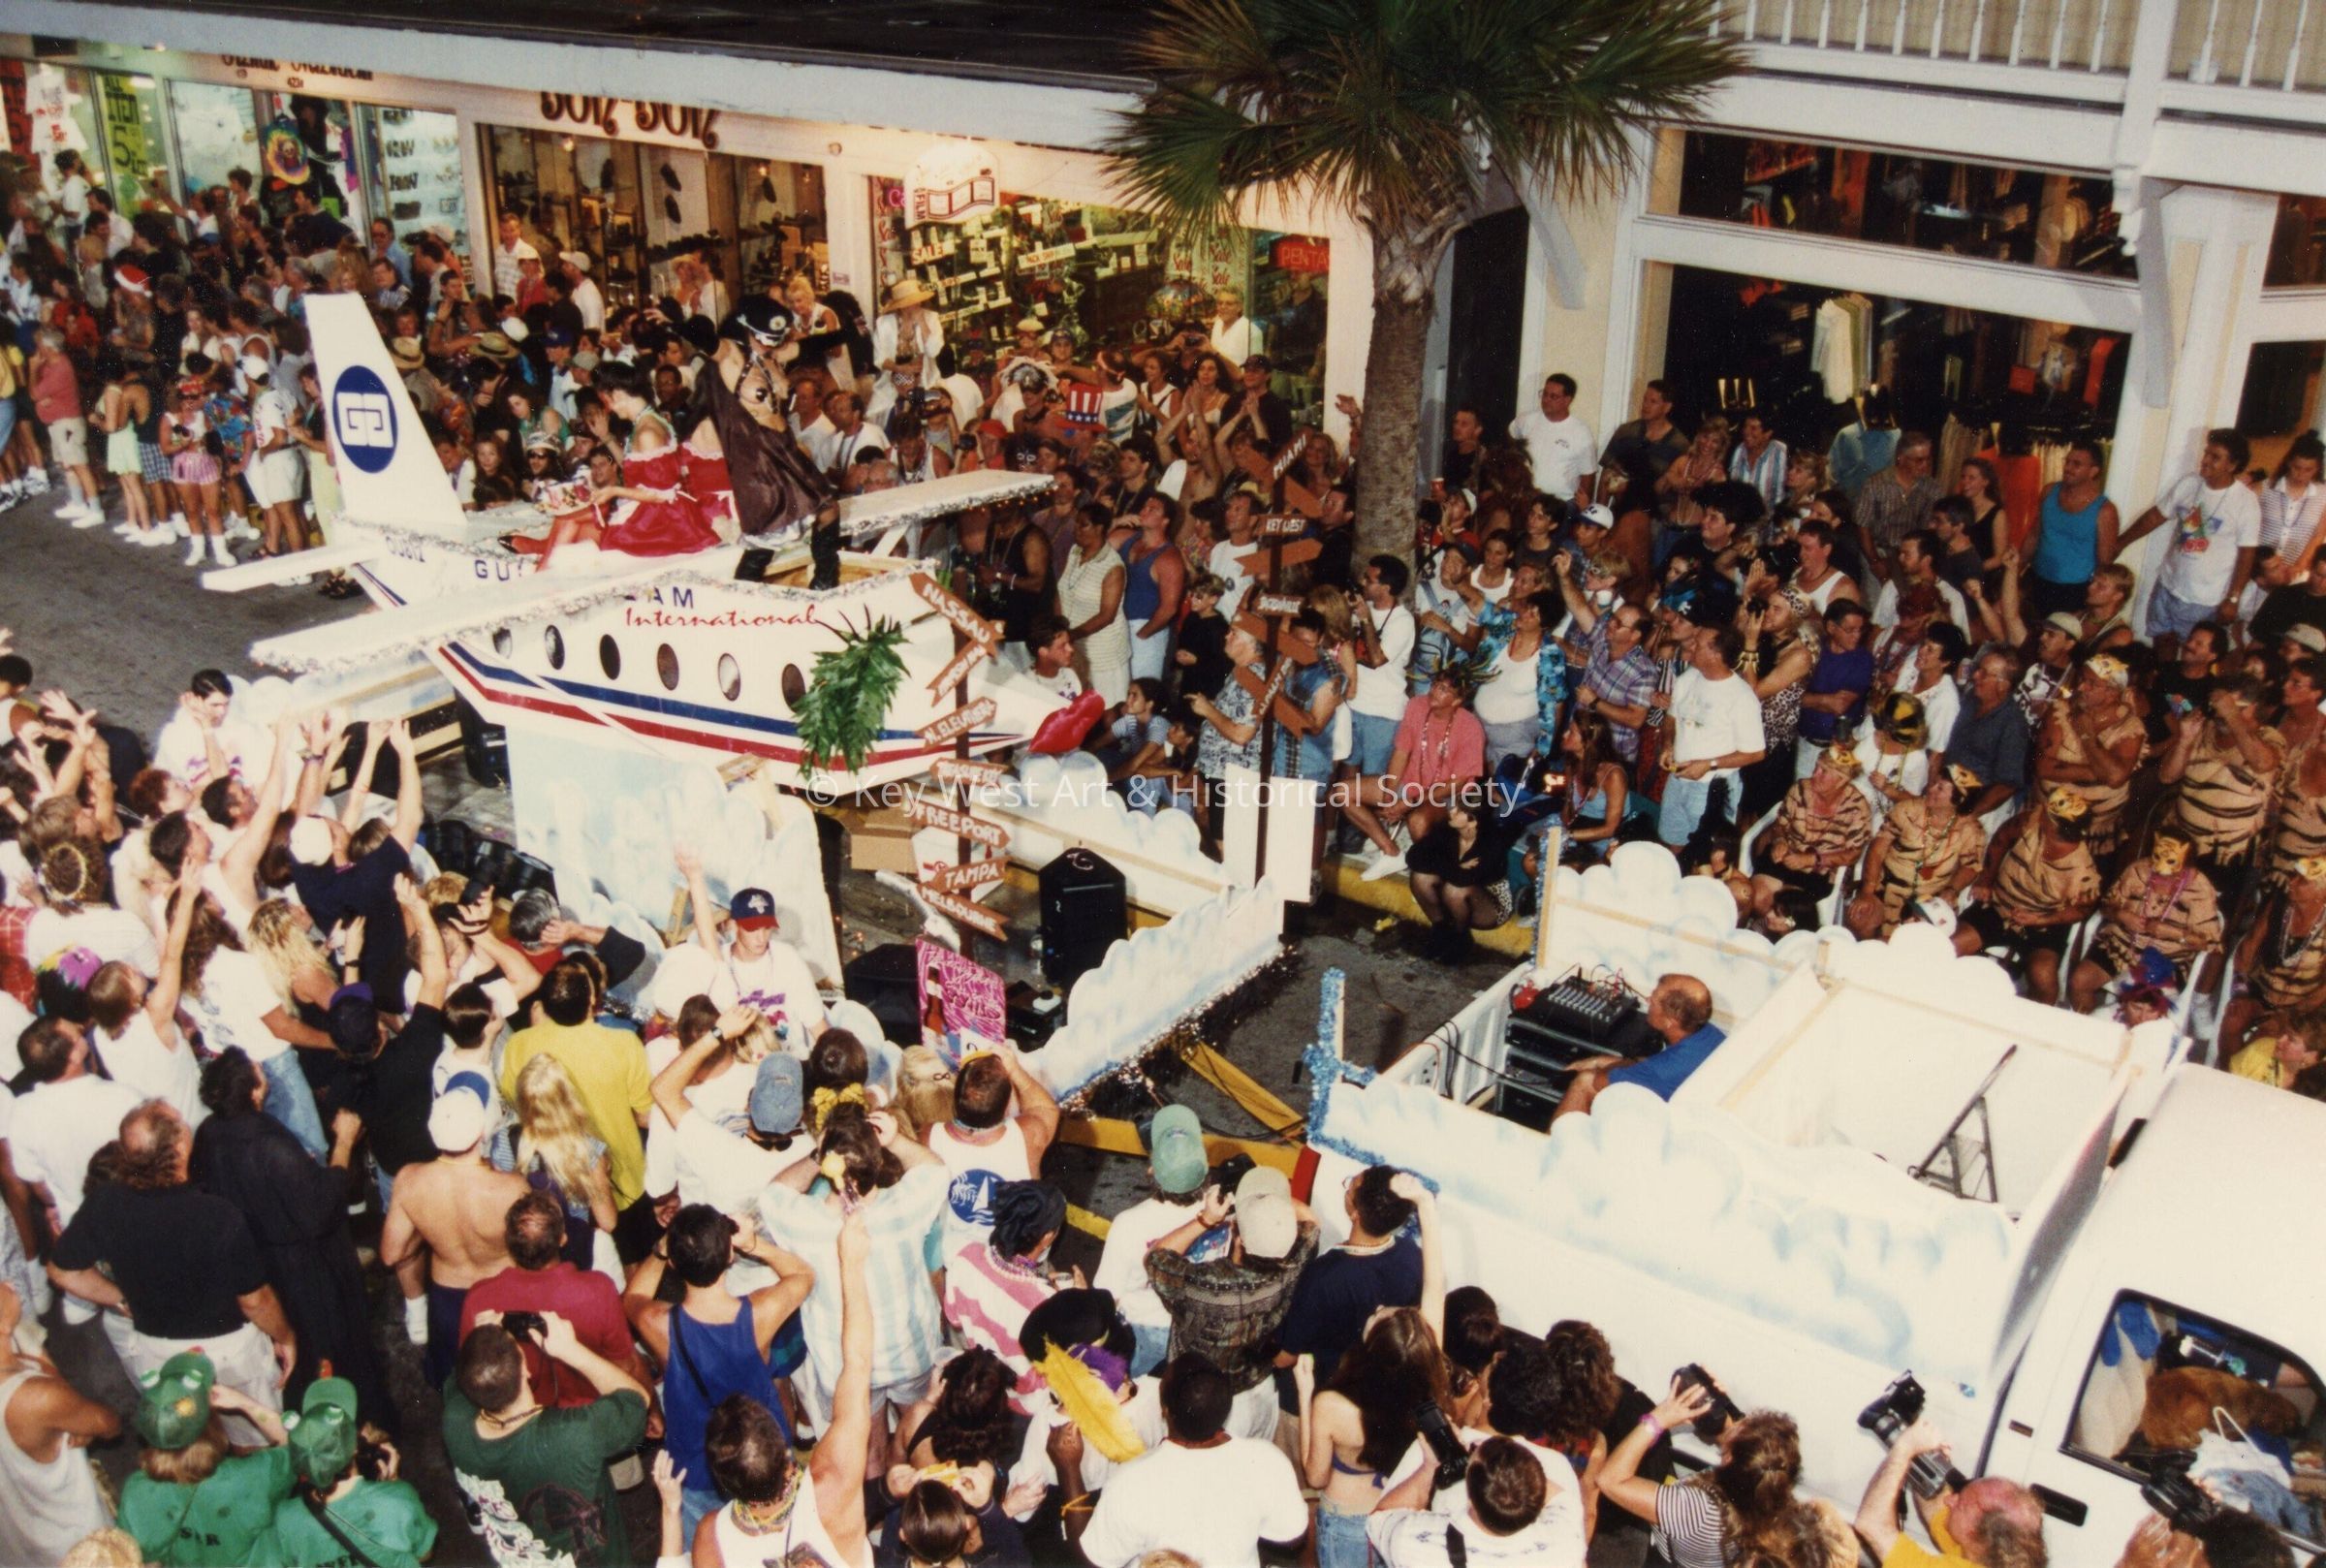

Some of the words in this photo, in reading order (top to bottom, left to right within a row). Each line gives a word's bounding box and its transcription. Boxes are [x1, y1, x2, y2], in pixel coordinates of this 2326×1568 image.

[915, 194, 927, 221] FILM
[911, 242, 945, 266] SALE
[1273, 433, 1306, 481] MIAMI
[1266, 517, 1281, 532] KEY
[1282, 517, 1306, 532] WEST
[625, 604, 818, 627] International
[923, 582, 990, 643] NASSAU
[915, 803, 1002, 845] FREEPORT
[945, 862, 999, 889] TAMPA
[922, 886, 998, 933] MELBOURNE
